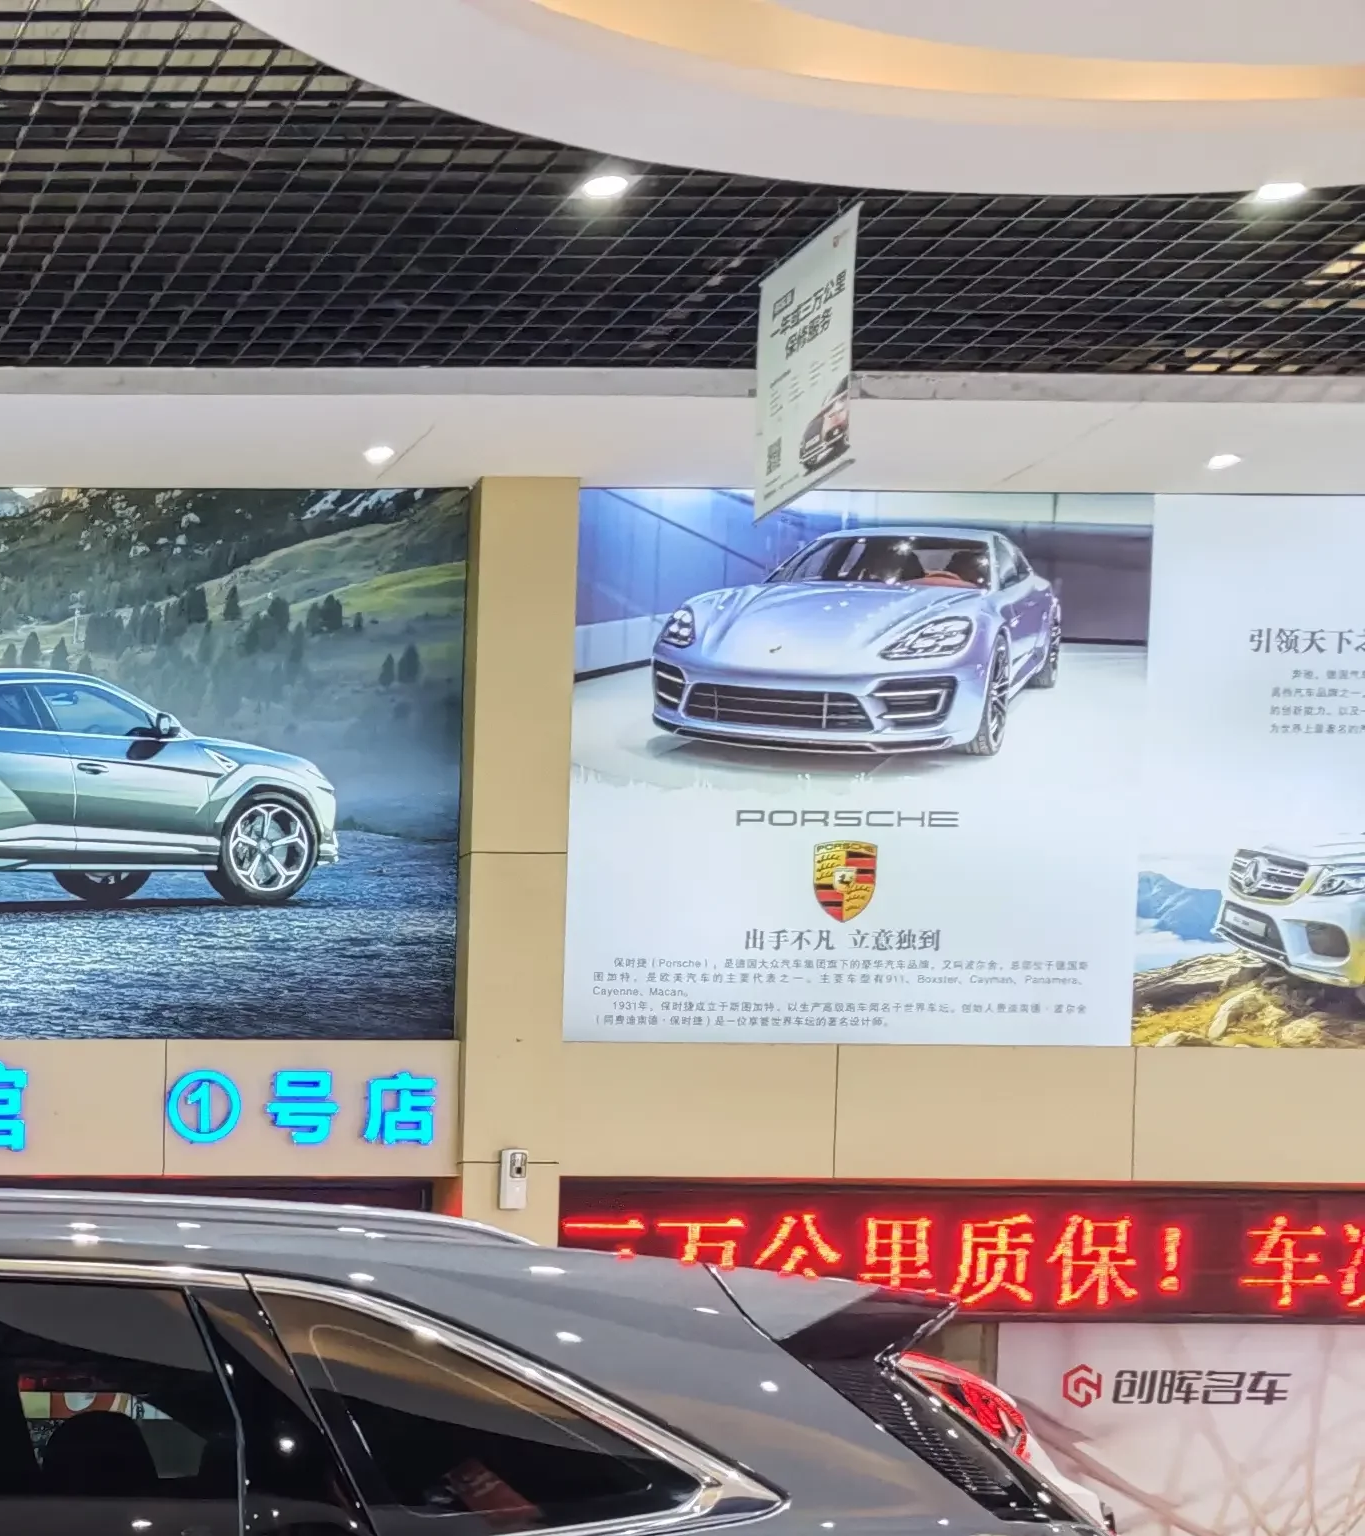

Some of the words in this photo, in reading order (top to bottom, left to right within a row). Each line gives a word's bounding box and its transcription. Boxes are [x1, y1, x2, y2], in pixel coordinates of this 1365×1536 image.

[735, 809, 960, 828] PORSCHE
[744, 928, 836, 951] 出手不凡
[848, 928, 941, 951] 立意独到
[1111, 1369, 1293, 1406] 创晖名车
